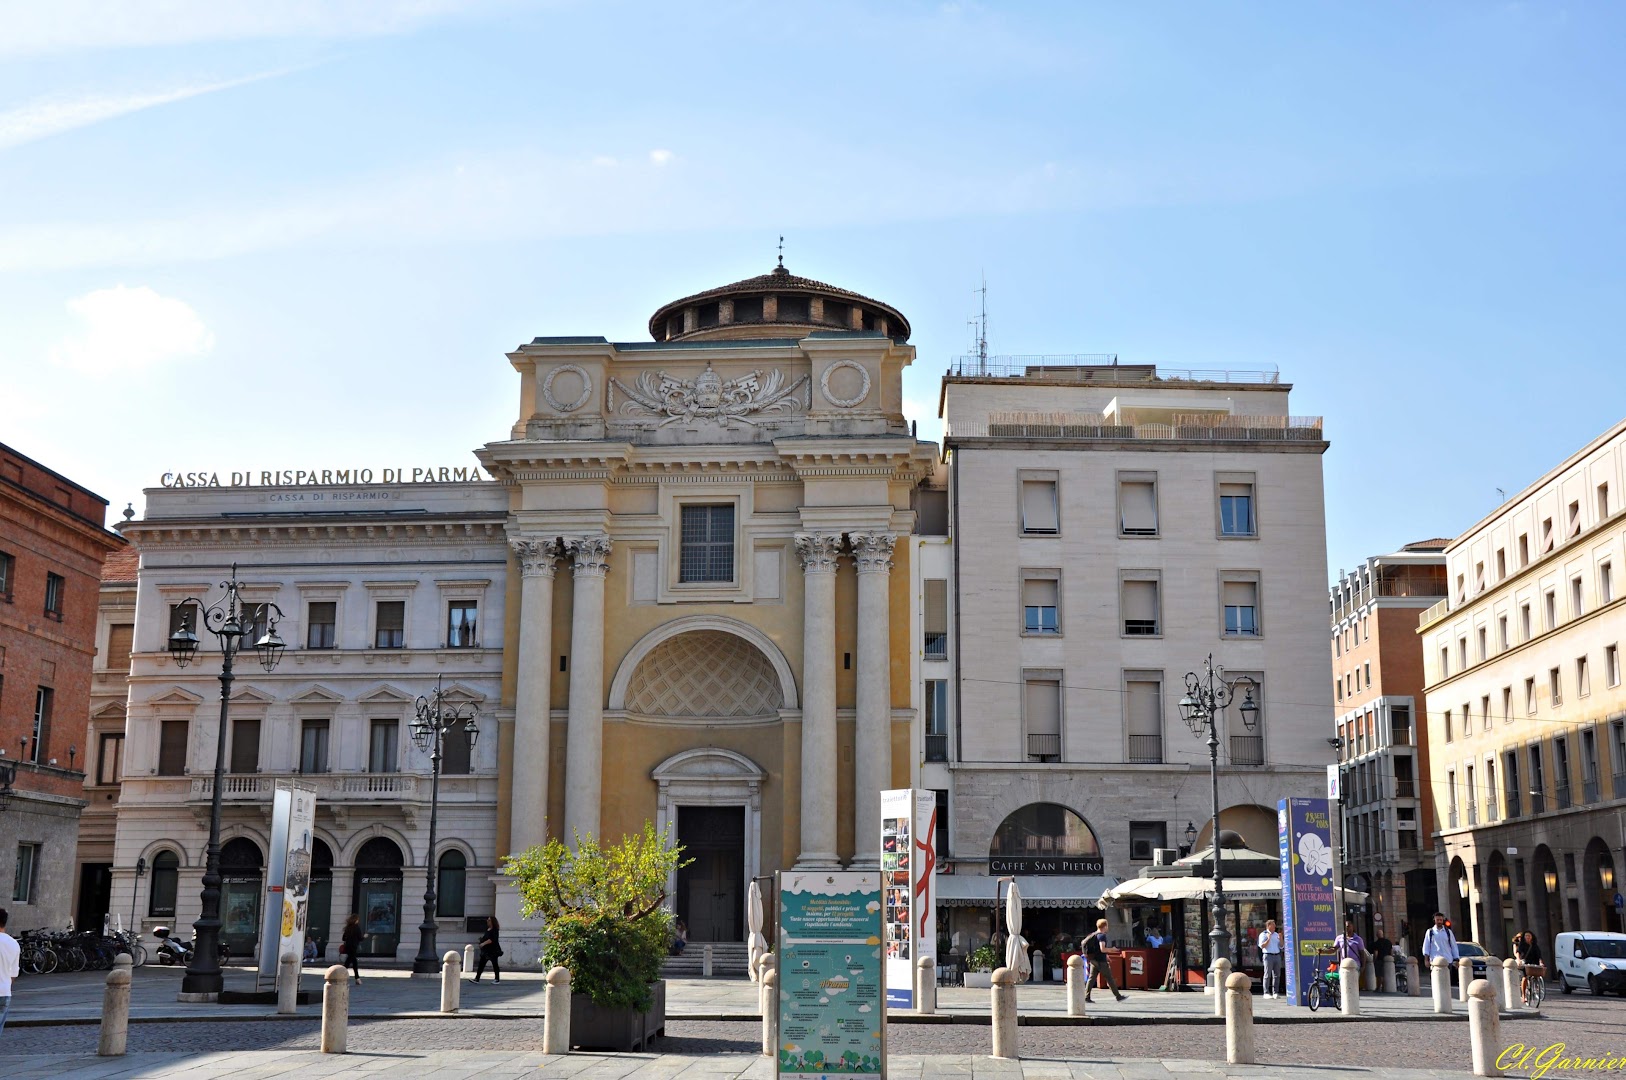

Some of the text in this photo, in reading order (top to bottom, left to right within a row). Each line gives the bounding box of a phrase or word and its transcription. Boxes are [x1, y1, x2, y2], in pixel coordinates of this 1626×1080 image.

[161, 467, 482, 488] CASSA DI RISPARMIO DI PARMA
[269, 492, 389, 502] CASSA DI RISPARMIO
[1305, 812, 1315, 823] 28
[1316, 819, 1329, 829] 2018
[991, 860, 1102, 871] CAFFE' SAN PIETRO
[1296, 883, 1314, 892] NOTTE
[1297, 892, 1333, 902] RICERCATORI
[1313, 904, 1332, 912] PARMA
